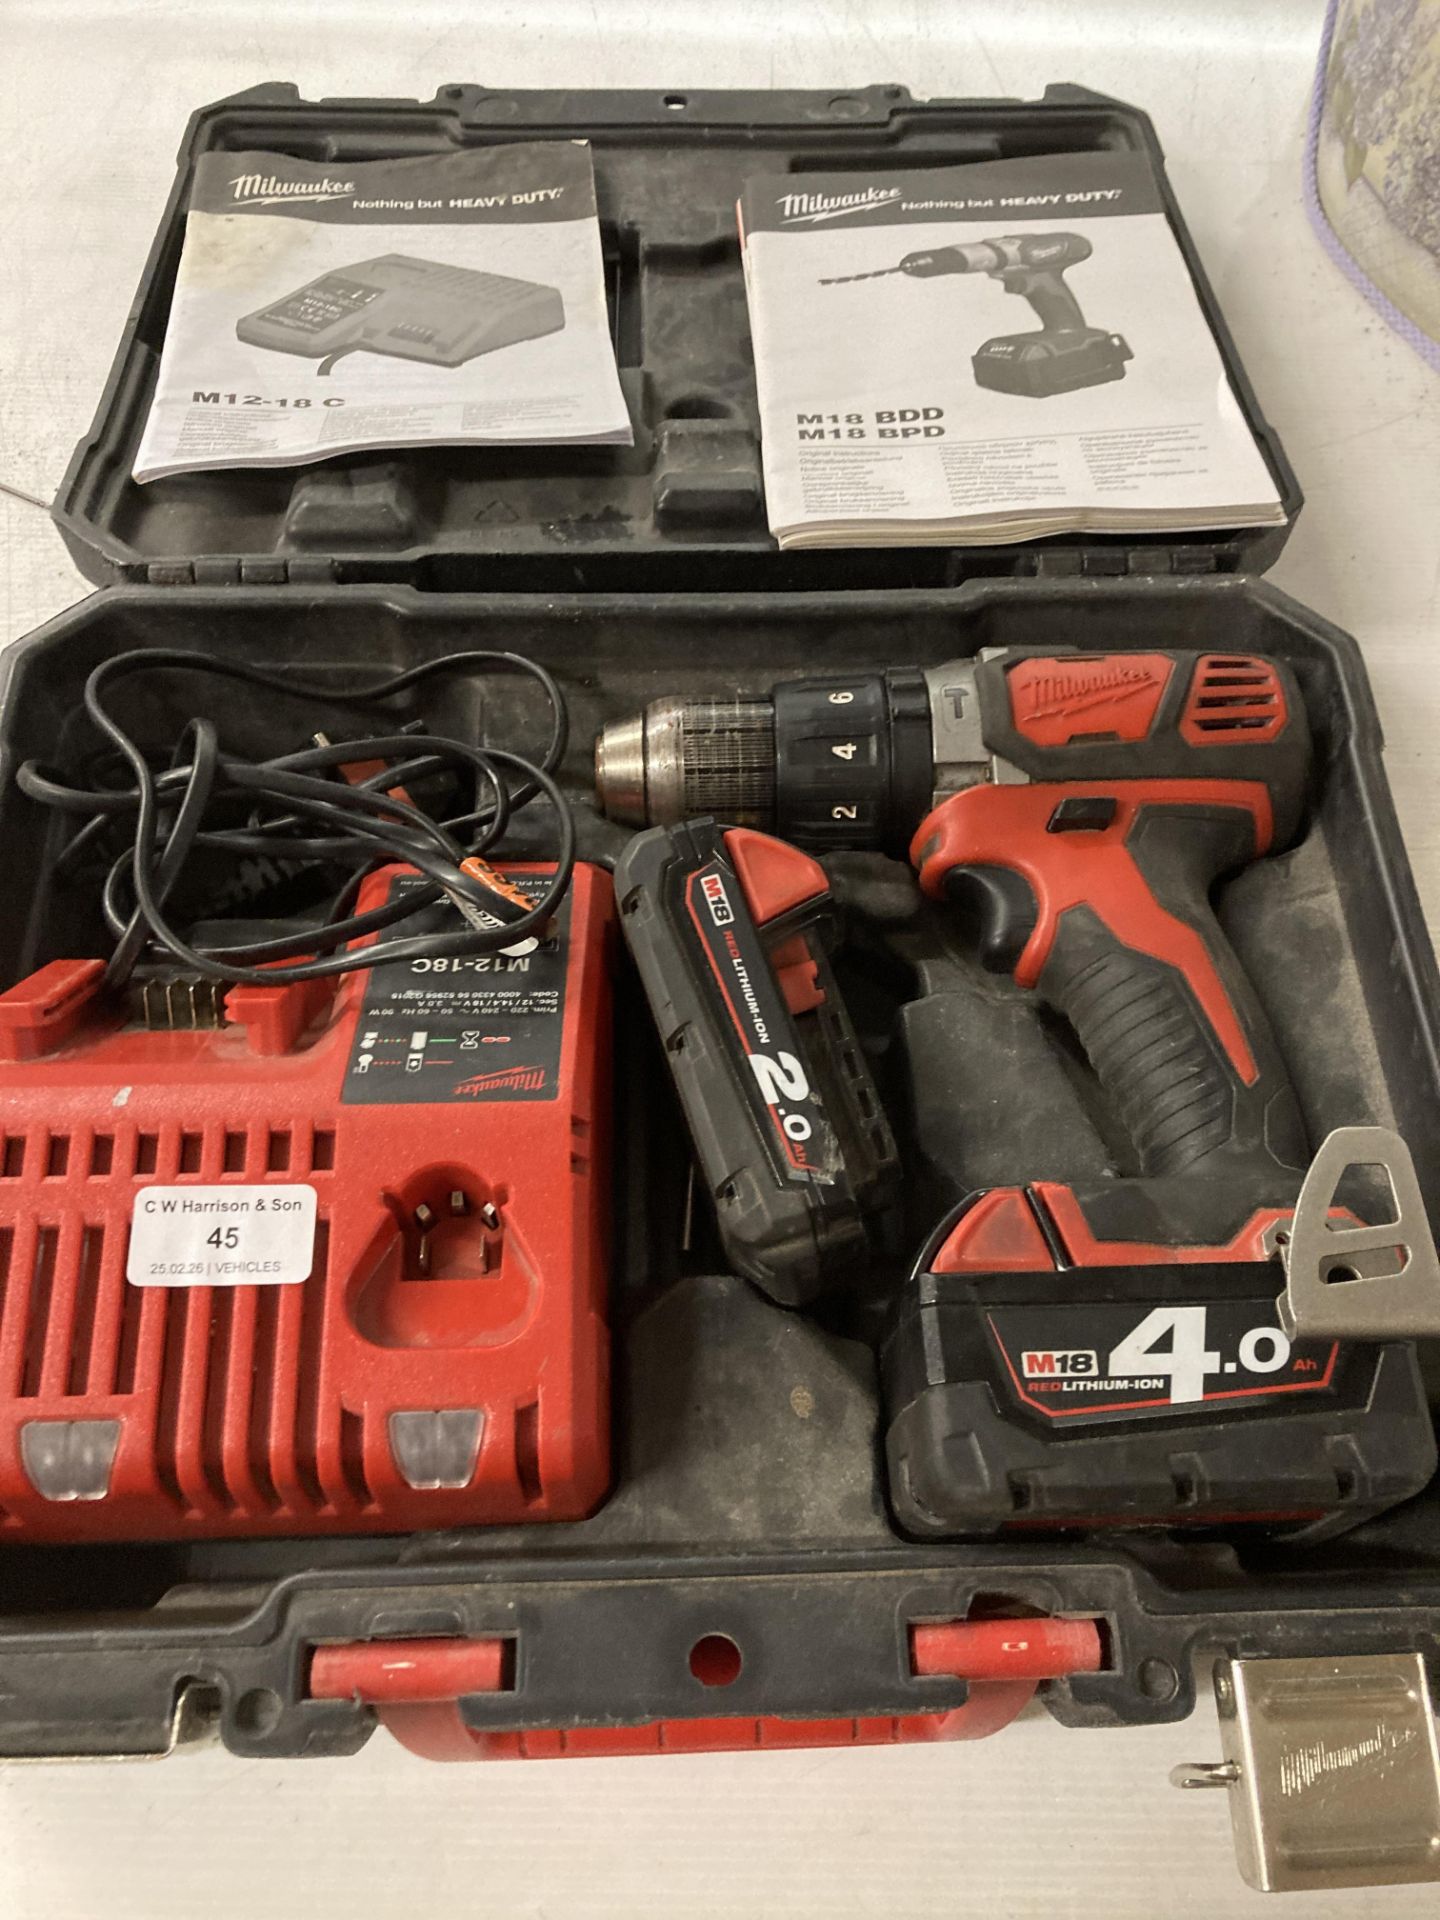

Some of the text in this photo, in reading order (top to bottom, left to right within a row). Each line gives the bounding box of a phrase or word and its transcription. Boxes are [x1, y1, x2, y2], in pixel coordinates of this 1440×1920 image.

[229, 175, 356, 201] Milwaukee
[353, 200, 412, 209] Nothing
[418, 199, 442, 208] but
[449, 196, 506, 208] HEAVY
[777, 187, 901, 217] Milwaukee
[902, 199, 964, 211] Nothing
[967, 199, 994, 208] but
[1000, 194, 1061, 207] HEAVY
[193, 391, 345, 409] M12-18 C
[797, 407, 944, 425] M18 BDD
[798, 425, 945, 441] M18 BPD
[828, 691, 854, 704] 6
[1020, 666, 1155, 715] Milwaukee
[832, 743, 857, 760] 4
[832, 806, 857, 819] 2
[703, 877, 731, 923] M18
[411, 957, 531, 973] M12-18C
[723, 929, 771, 1044] REDLITHIUM-ION
[453, 1070, 547, 1097] Milwaukee
[747, 1051, 812, 1141] 2.0
[144, 1198, 302, 1214] C W Harrison & Son
[206, 1226, 239, 1249] 45
[150, 1262, 204, 1275] 25.02.26
[215, 1260, 281, 1274] VEHICLES
[1026, 1352, 1093, 1375] M18
[1108, 1306, 1318, 1404] 4.0 Ah
[1027, 1379, 1164, 1393] REDLITHIUM-ION
